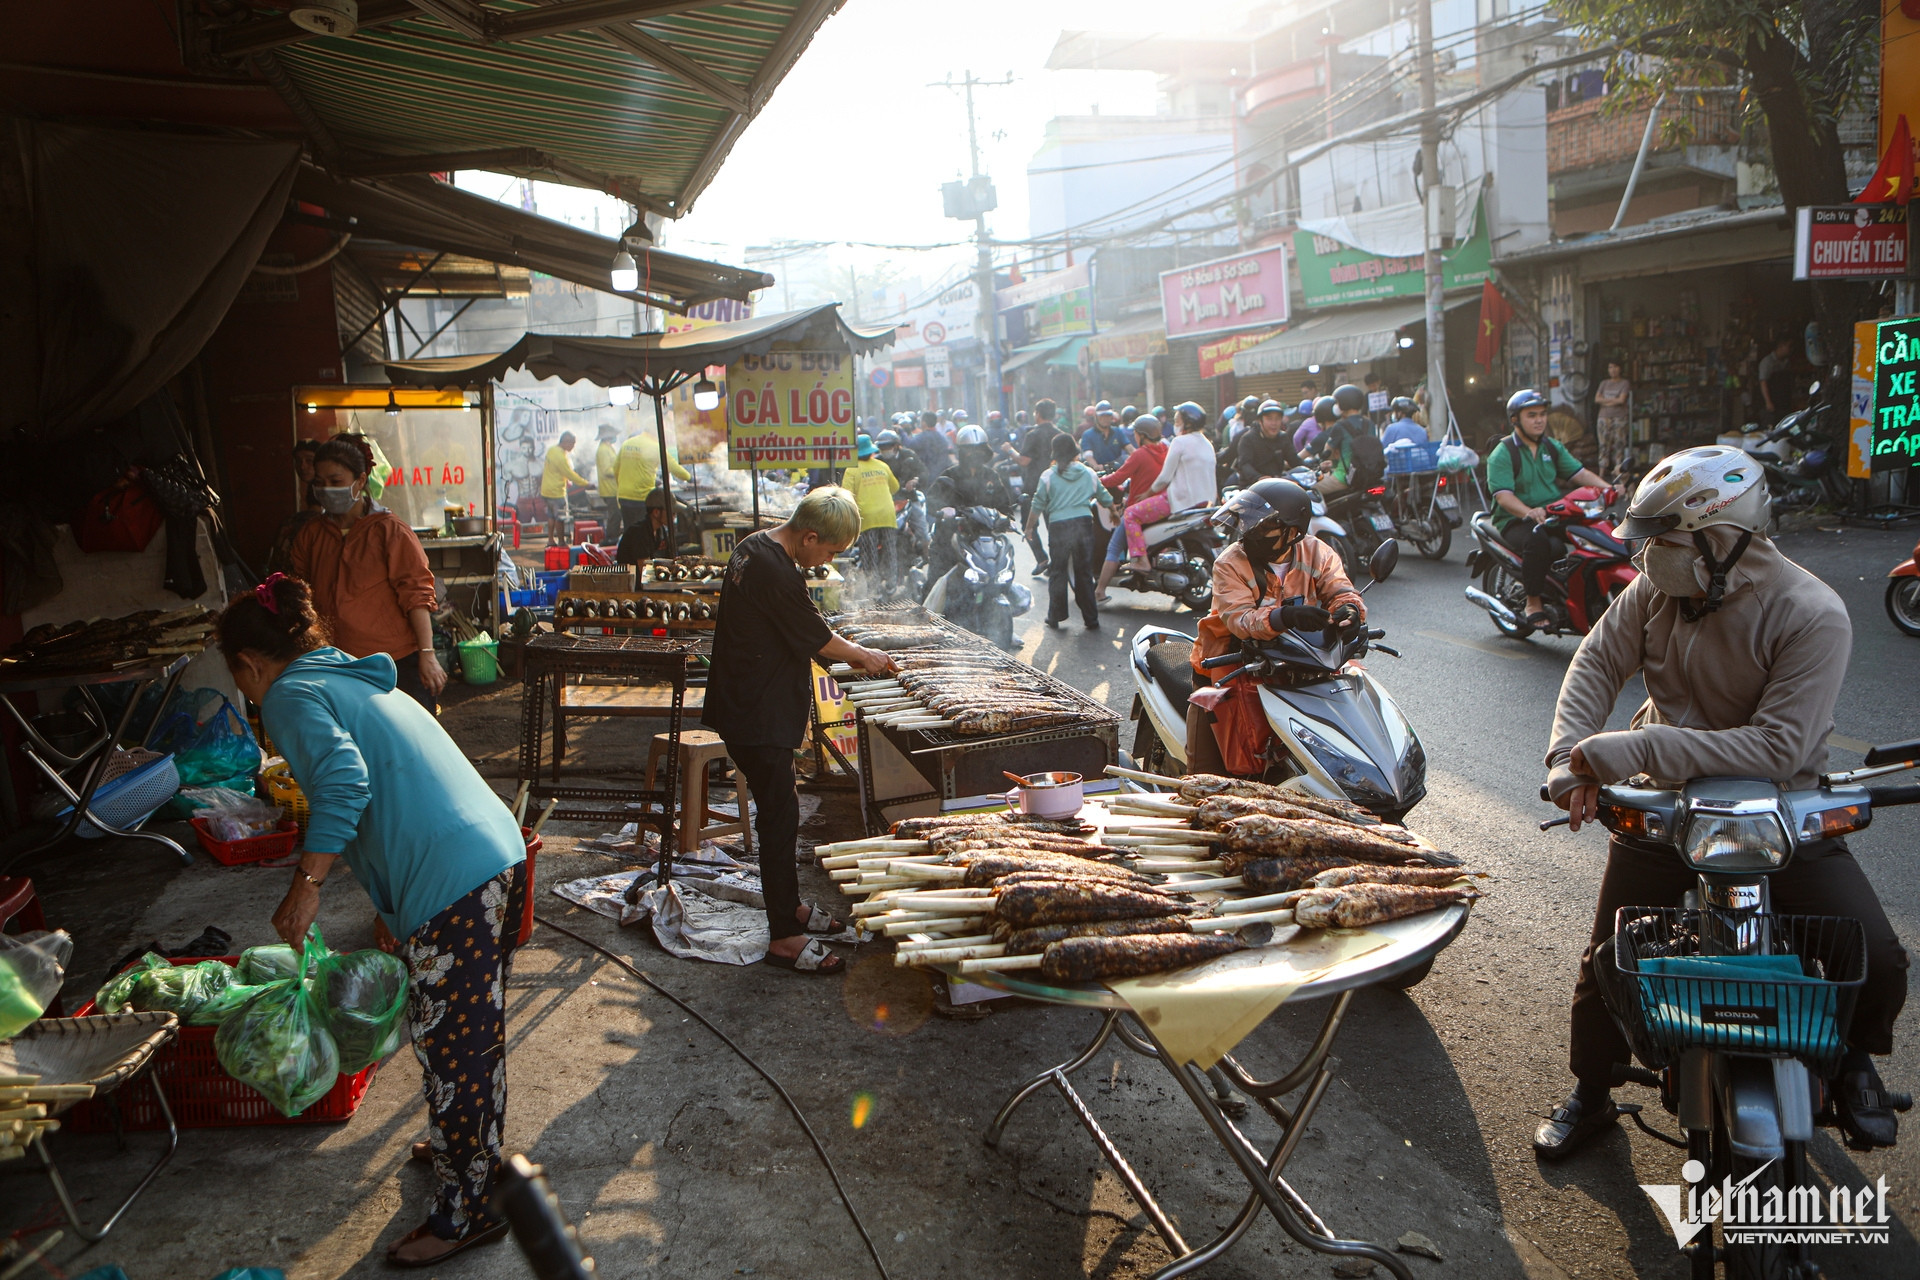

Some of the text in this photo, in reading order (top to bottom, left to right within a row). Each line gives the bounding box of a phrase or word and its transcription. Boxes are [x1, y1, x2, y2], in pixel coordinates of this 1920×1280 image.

[1817, 208, 1906, 223] Dịch Vụ 24/7
[1813, 231, 1870, 264] CHUYỂN
[1238, 259, 1260, 276] Sinh
[1179, 281, 1265, 325] Mum Mum
[1889, 371, 1917, 398] XE
[734, 381, 781, 426] CÁ
[789, 381, 852, 426] LÓC
[535, 409, 559, 433] GYM
[736, 431, 807, 462] NƯỚNG
[812, 431, 851, 462] MÍA
[1715, 1011, 1759, 1019] HONDA
